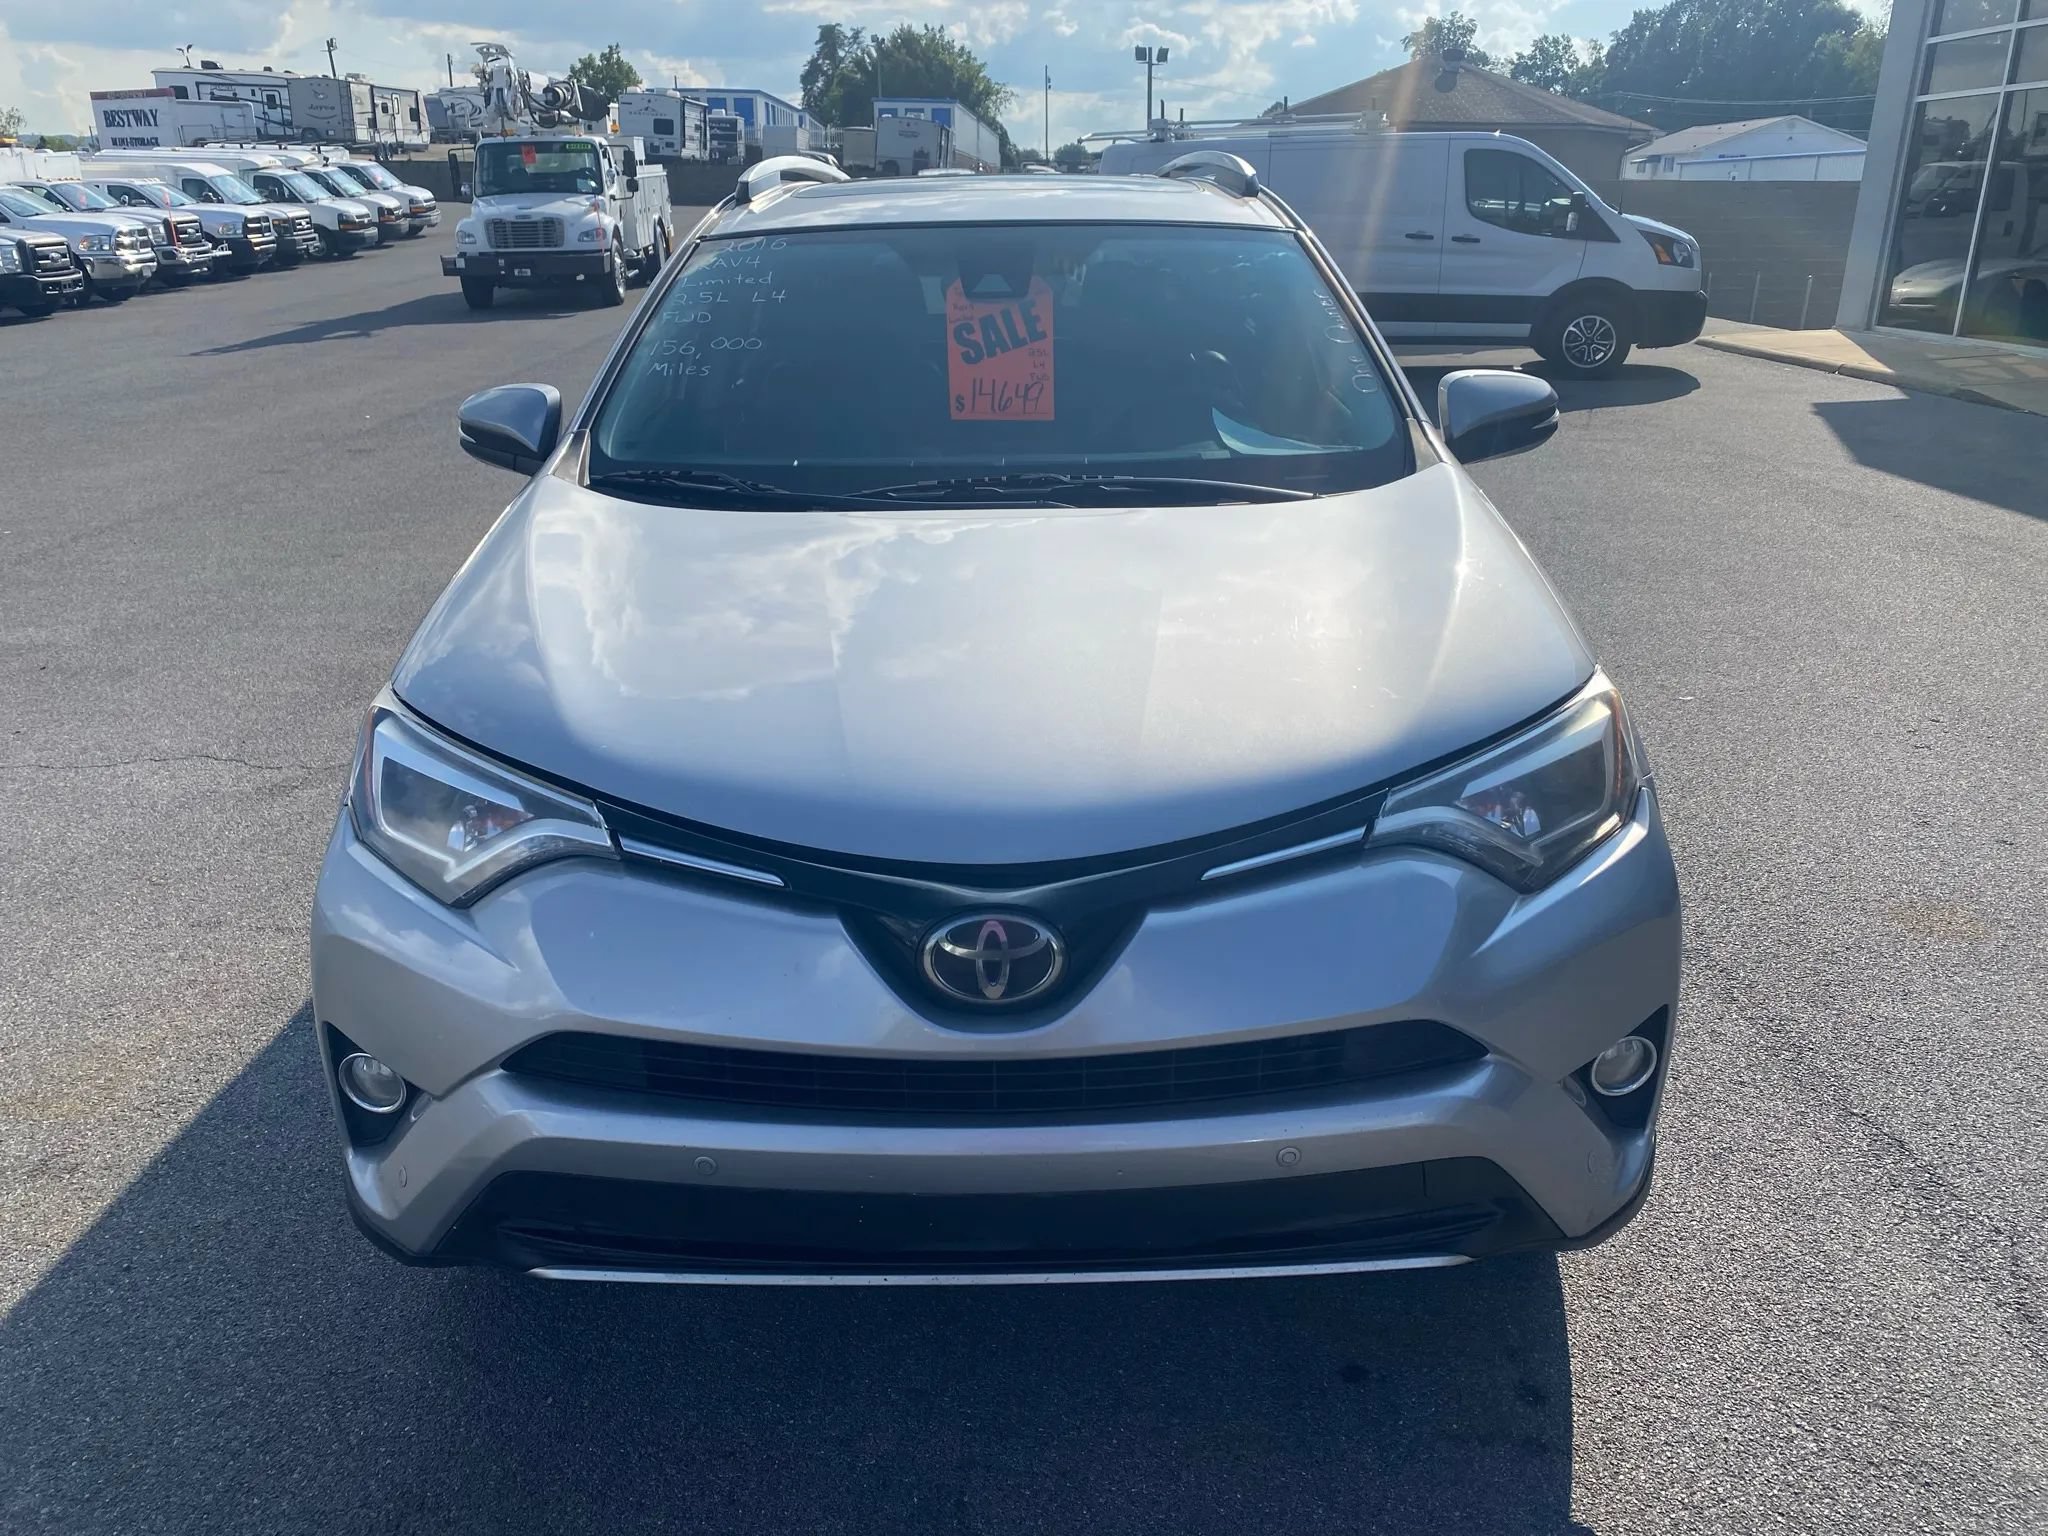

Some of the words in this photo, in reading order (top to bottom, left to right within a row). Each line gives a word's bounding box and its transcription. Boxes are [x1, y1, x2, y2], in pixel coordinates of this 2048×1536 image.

[103, 109, 159, 128] BESTWAY
[719, 236, 788, 253] 2016
[682, 271, 773, 288] Limited
[676, 291, 729, 306] 2.5L
[662, 310, 712, 324] FWD
[953, 300, 1048, 365] SALE
[647, 361, 711, 377] Miles
[1348, 354, 1379, 393] One
